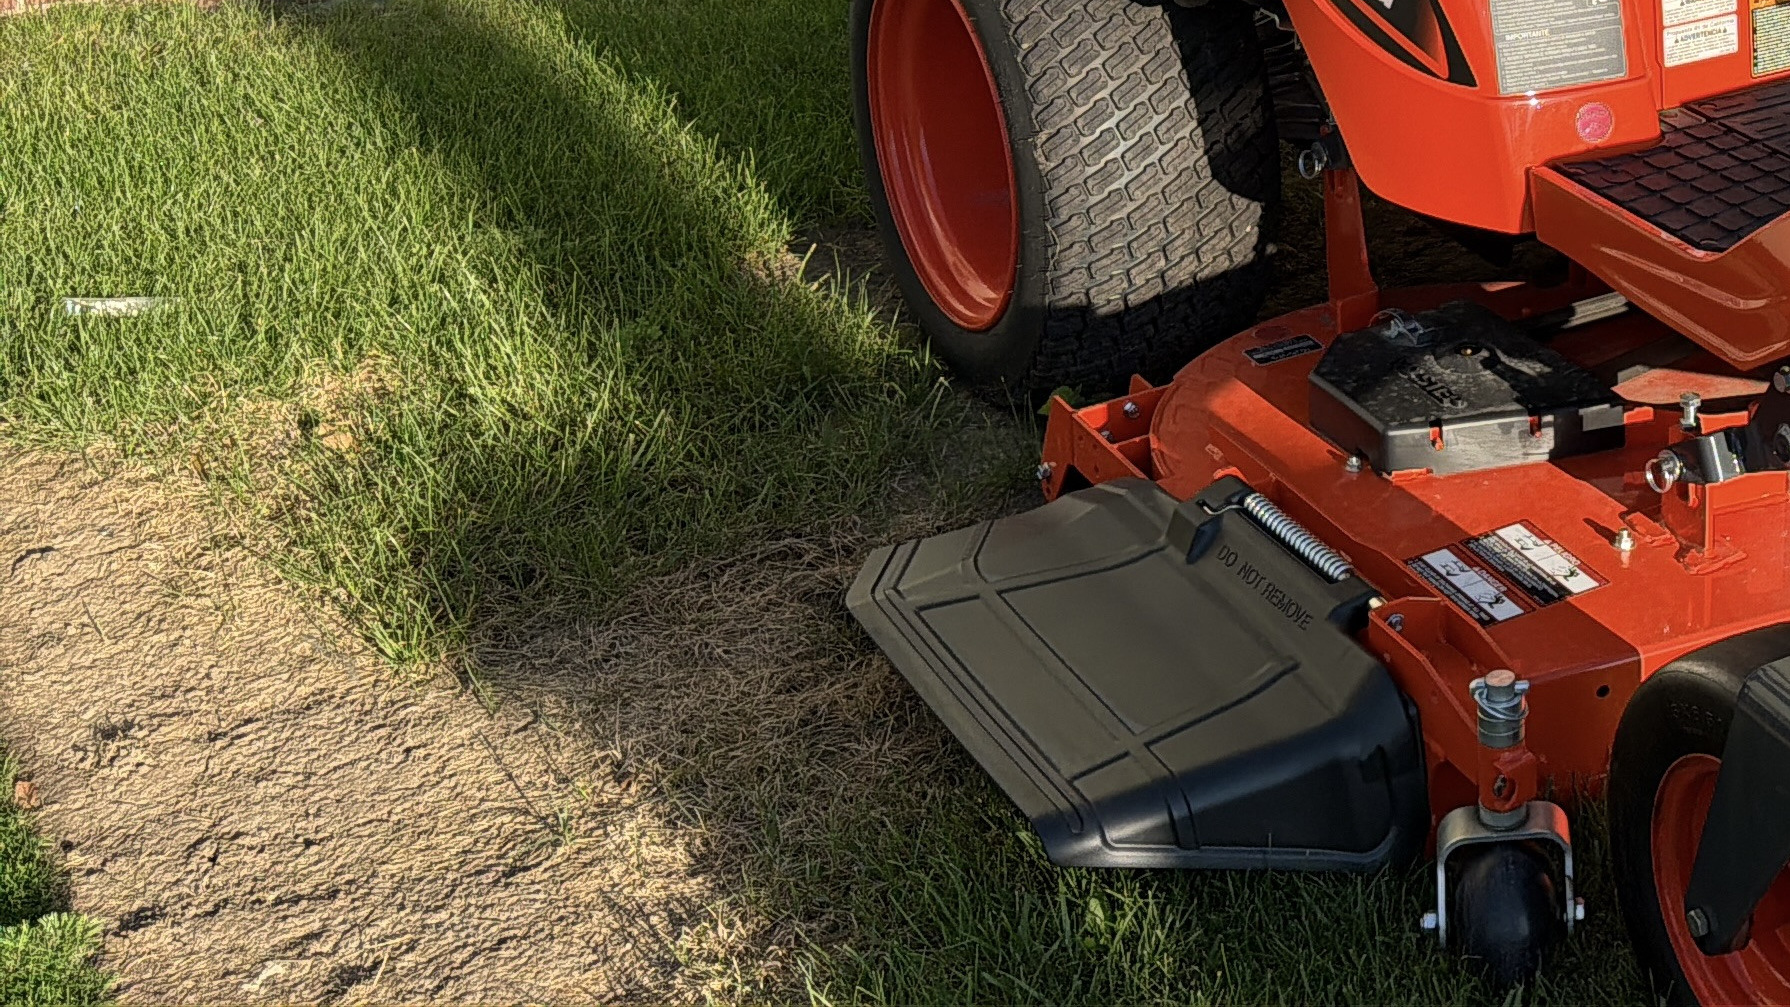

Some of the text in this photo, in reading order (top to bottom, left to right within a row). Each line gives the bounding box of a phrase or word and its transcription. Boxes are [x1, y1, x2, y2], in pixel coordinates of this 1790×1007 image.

[1505, 29, 1550, 41] IMPORTANTE
[1217, 544, 1314, 631] DO NOT REMOVE
